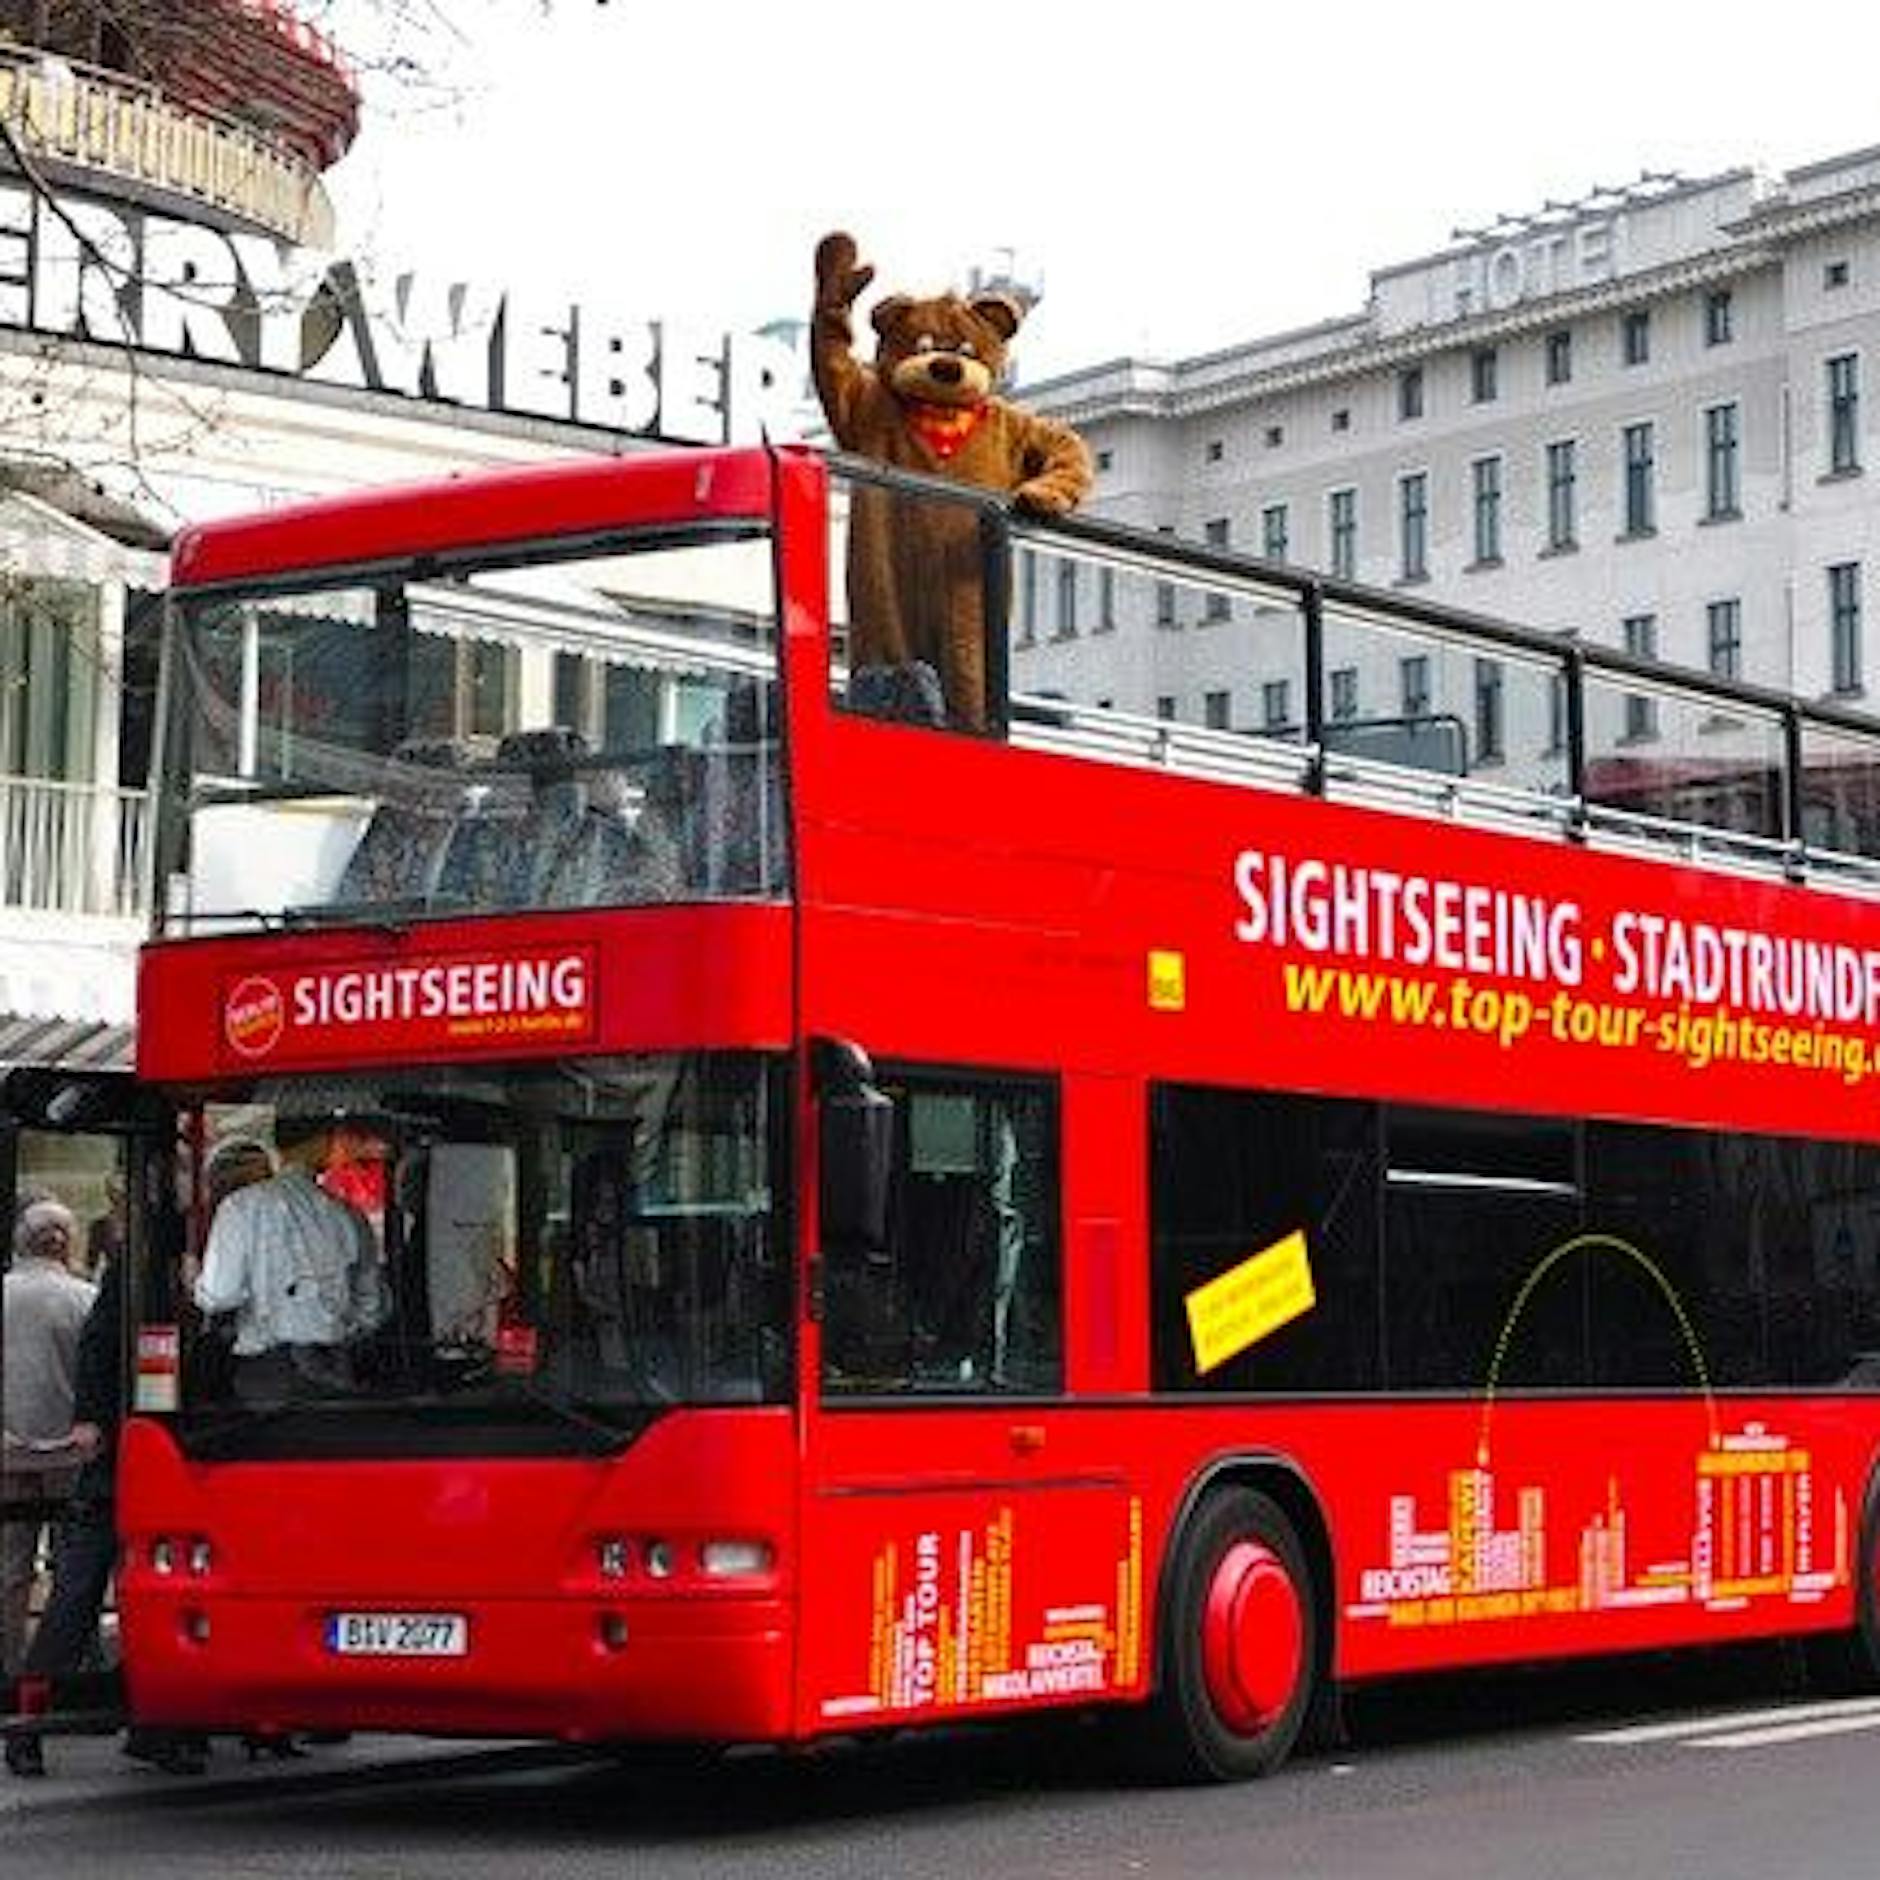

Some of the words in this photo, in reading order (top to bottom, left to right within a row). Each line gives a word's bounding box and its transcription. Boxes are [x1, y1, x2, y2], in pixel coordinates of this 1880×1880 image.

[343, 260, 806, 448] WEBER
[1234, 850, 1582, 986] SIGHTSEEING
[293, 956, 585, 1026] SIGHTSEEING
[916, 1531, 940, 1629] TOUR
[914, 1636, 935, 1705] TOP
